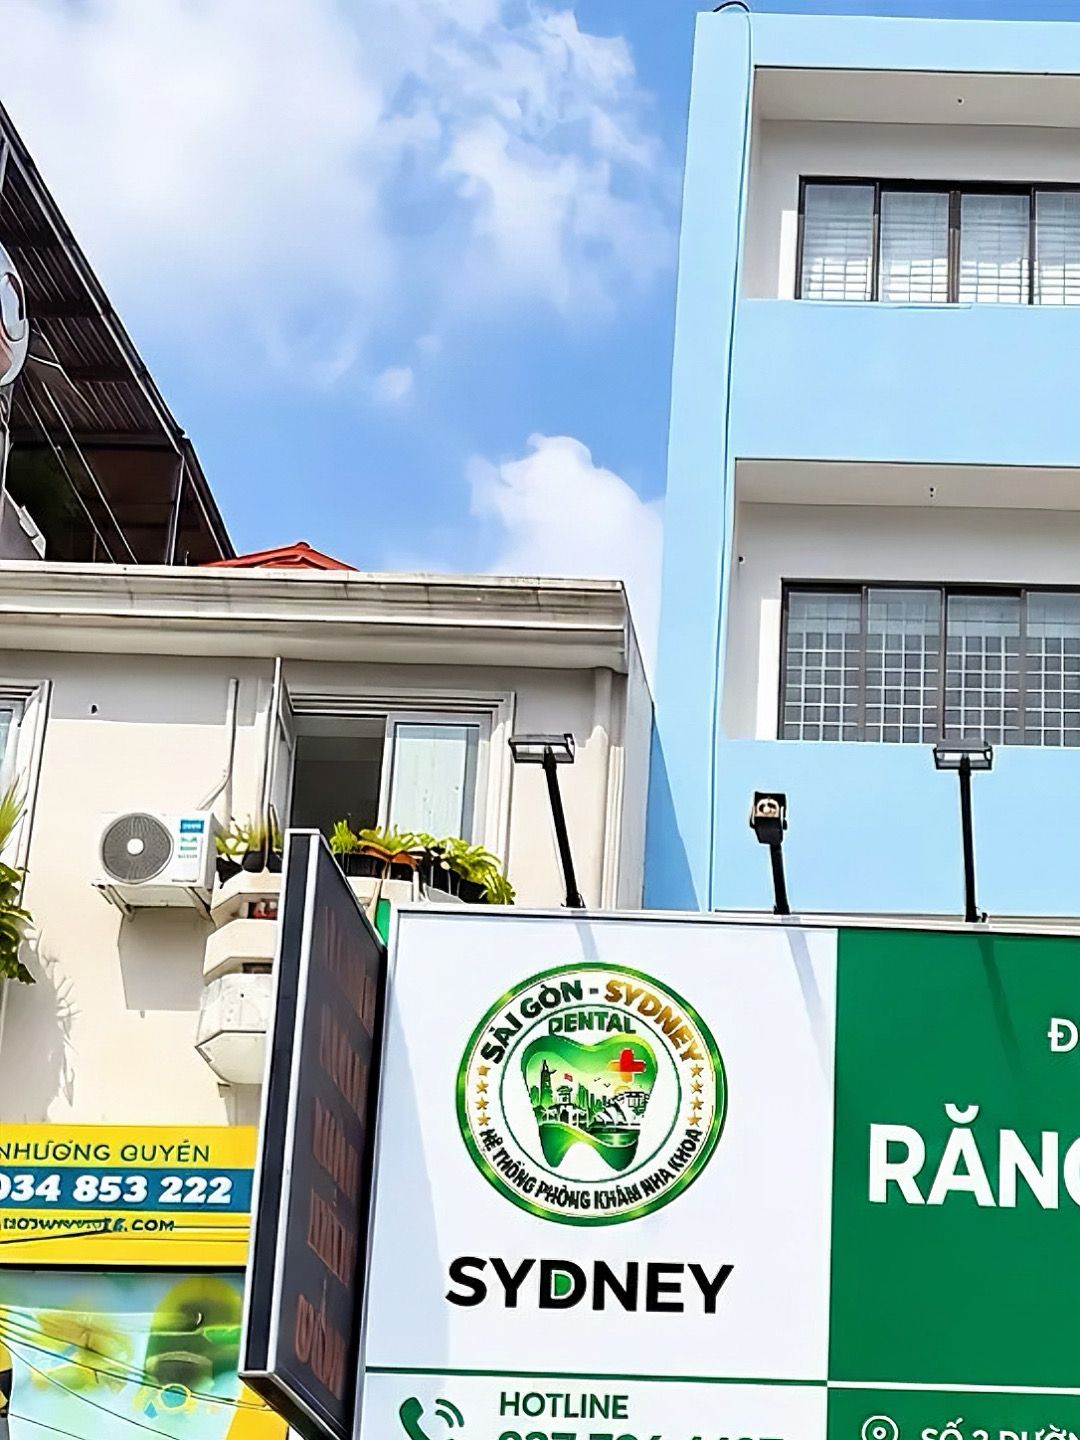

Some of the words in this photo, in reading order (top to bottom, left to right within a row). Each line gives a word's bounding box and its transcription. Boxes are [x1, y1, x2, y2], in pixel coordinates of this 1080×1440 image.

[481, 1011, 523, 1065] SÀI
[520, 980, 584, 1019] GÒN
[604, 979, 704, 1063] SYDNEY
[548, 1011, 636, 1035] DENTAL
[639, 1168, 677, 1198] NHA
[667, 1128, 703, 1172] KHOA
[72, 1175, 148, 1203] 853
[158, 1176, 233, 1204] 222
[444, 1257, 735, 1314] SYDNEY
[500, 1392, 629, 1420] HOTLINE
